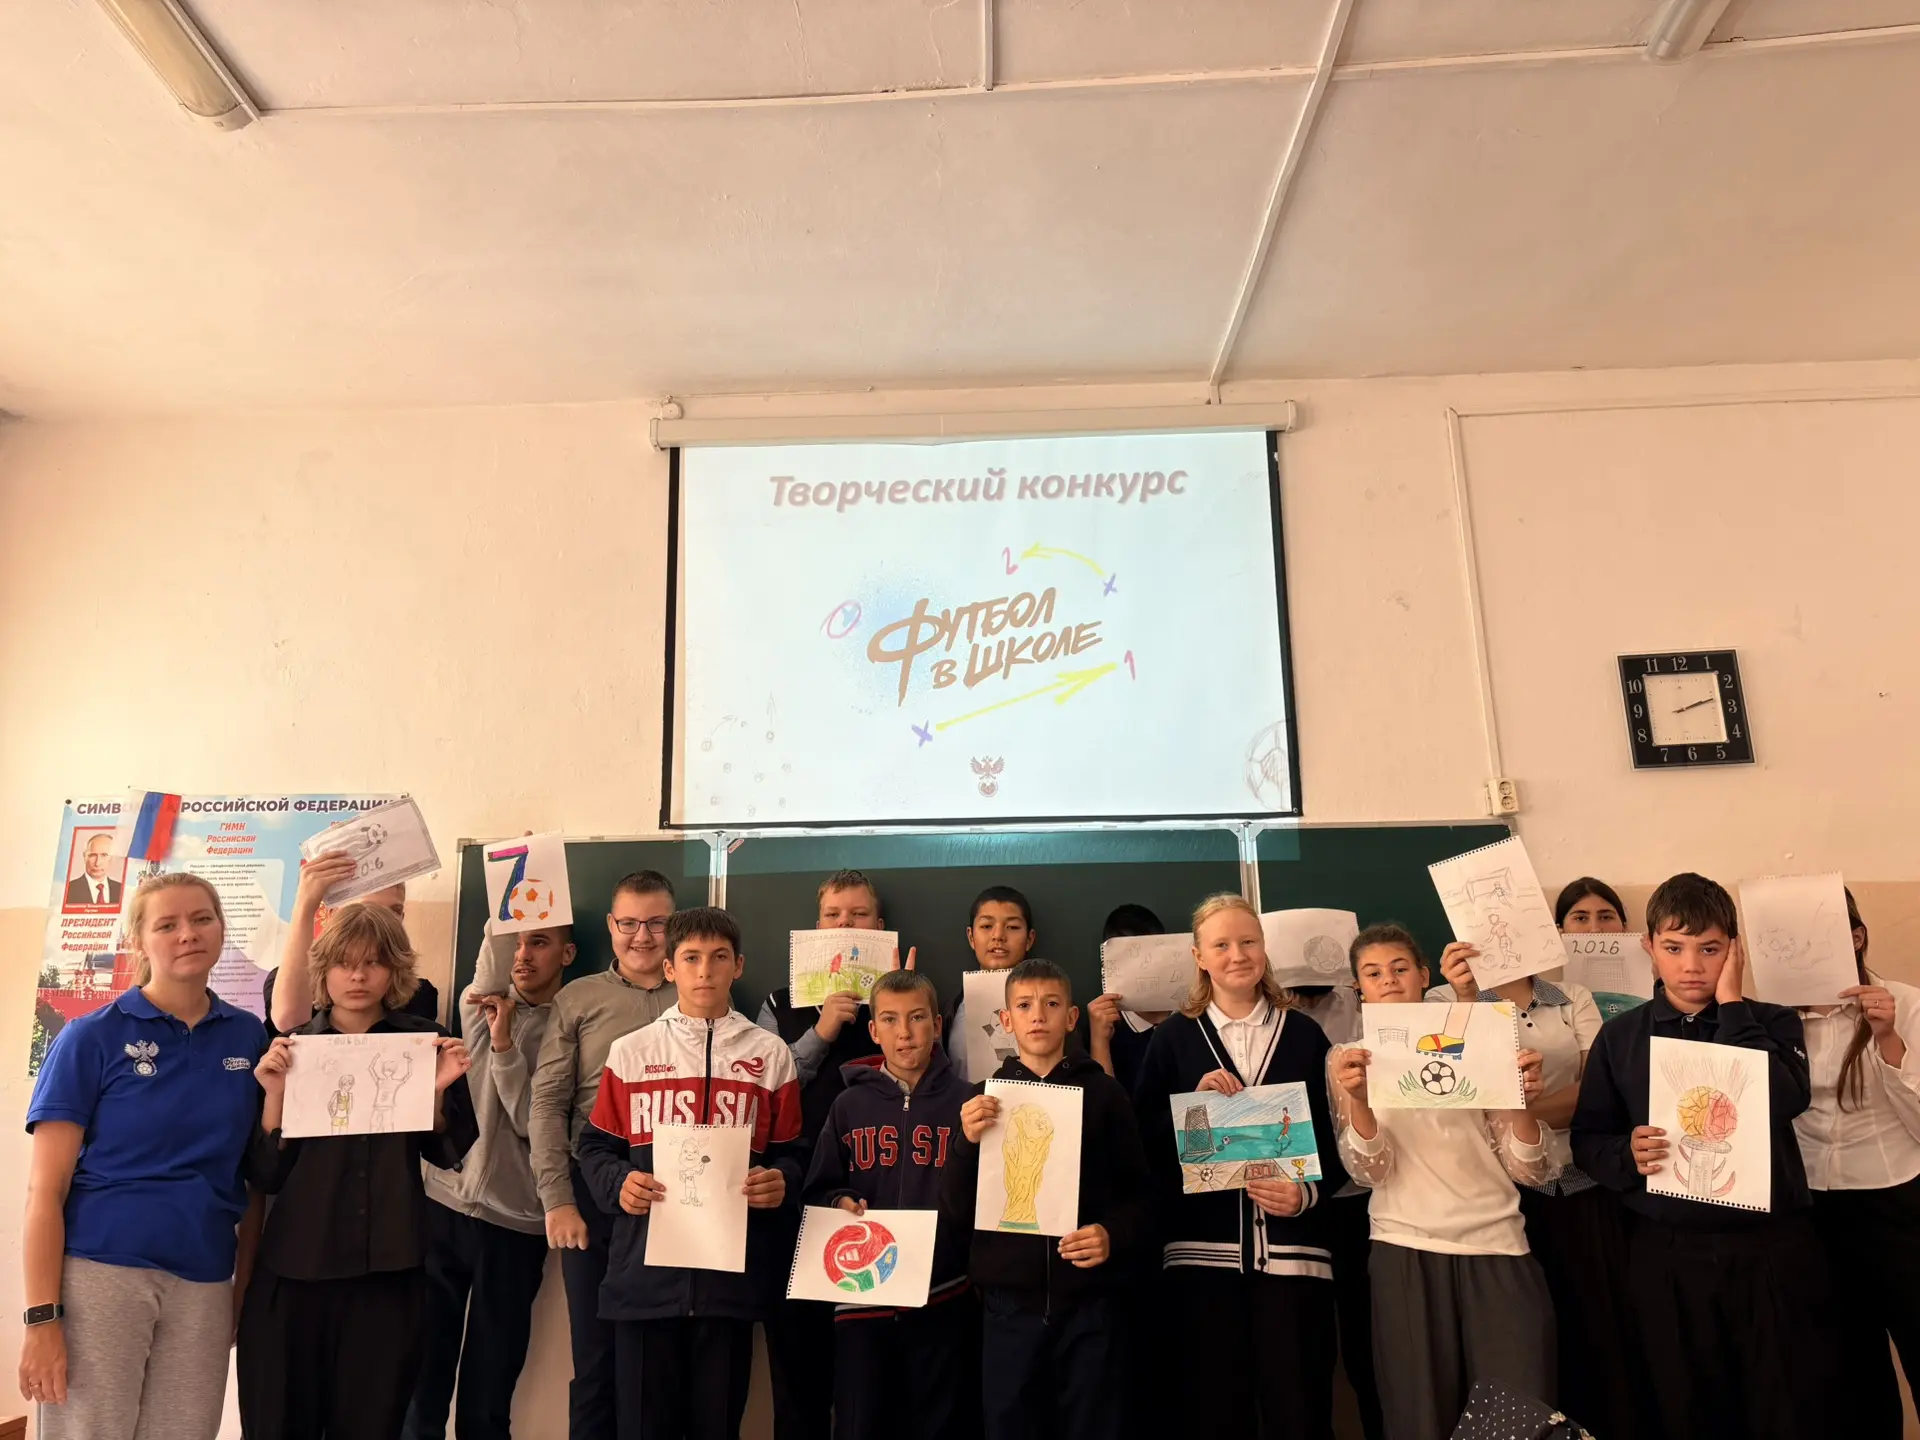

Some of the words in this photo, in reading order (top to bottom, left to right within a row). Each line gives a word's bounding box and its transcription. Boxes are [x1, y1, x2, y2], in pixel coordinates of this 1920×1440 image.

[769, 467, 1007, 514] Творческий
[1017, 469, 1189, 504] конкурс
[962, 620, 1103, 690] ШКОЛЕ
[1644, 657, 1660, 673] 11
[1671, 656, 1689, 671] 12
[1703, 655, 1713, 670] 1
[1626, 679, 1643, 694] 10
[1723, 674, 1734, 689] 2
[1633, 703, 1643, 719] 9
[1727, 699, 1738, 714] 3
[1637, 728, 1648, 743] 8
[1732, 723, 1743, 738] 4
[1660, 747, 1669, 762] 7
[1687, 746, 1698, 761] 6
[1715, 745, 1726, 760] 5
[180, 797, 289, 813] РОССИЙСКОЙ
[293, 798, 396, 814] ФЕДЕРАЦИ
[219, 822, 247, 831] ГИМН
[206, 833, 257, 843] Российской
[206, 845, 254, 856] Федерации
[60, 917, 117, 928] ПРЕЗИДЕНТ
[61, 929, 113, 939] Российской
[61, 942, 109, 952] Федерации
[1572, 939, 1620, 955] 2026
